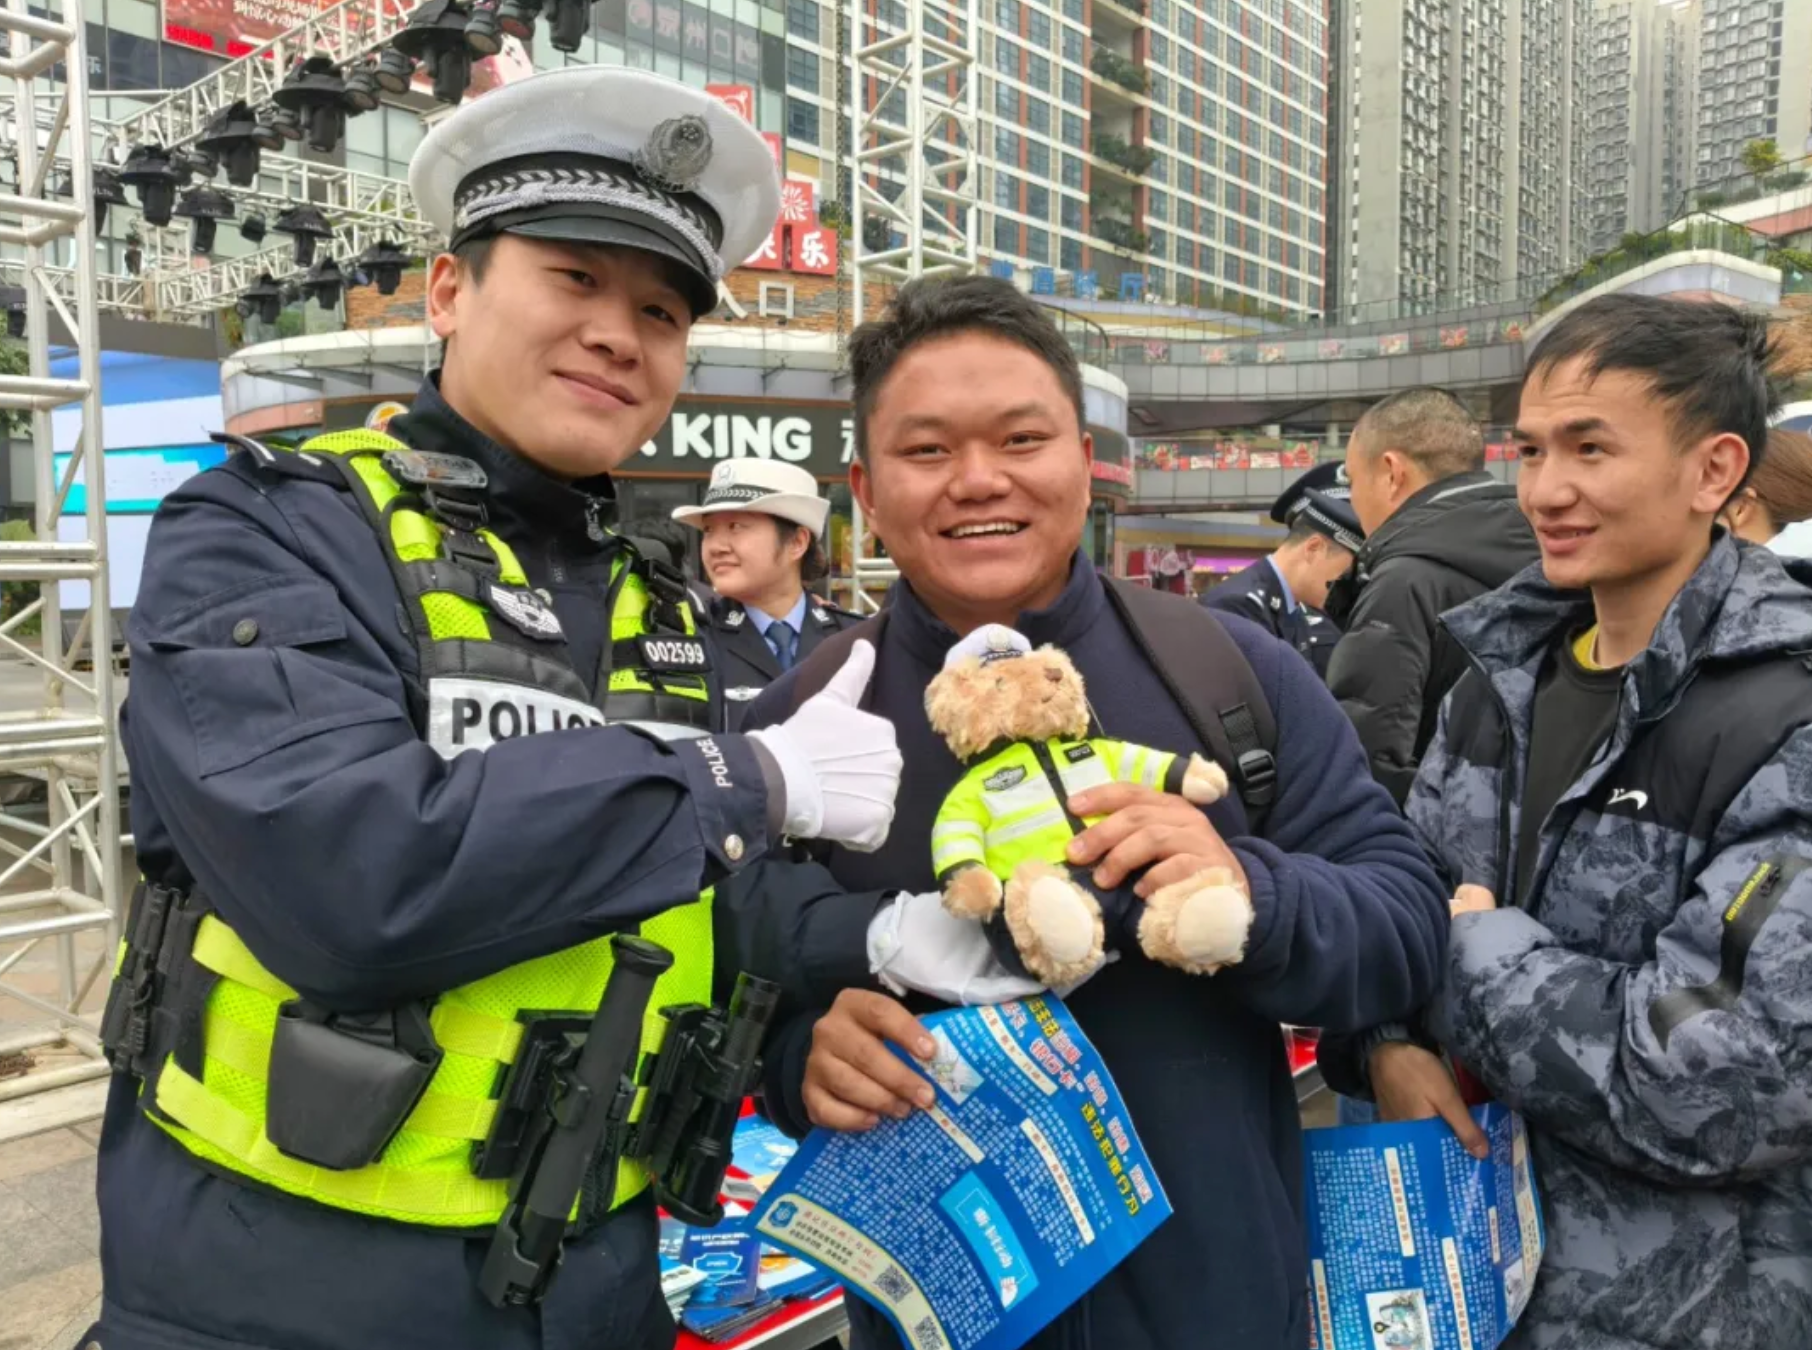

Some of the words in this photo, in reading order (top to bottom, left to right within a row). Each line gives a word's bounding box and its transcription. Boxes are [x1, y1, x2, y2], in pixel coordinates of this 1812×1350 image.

[717, 279, 794, 319] 入口
[671, 412, 812, 462] KING
[645, 640, 705, 664] 002599
[696, 737, 734, 788] POLICE
